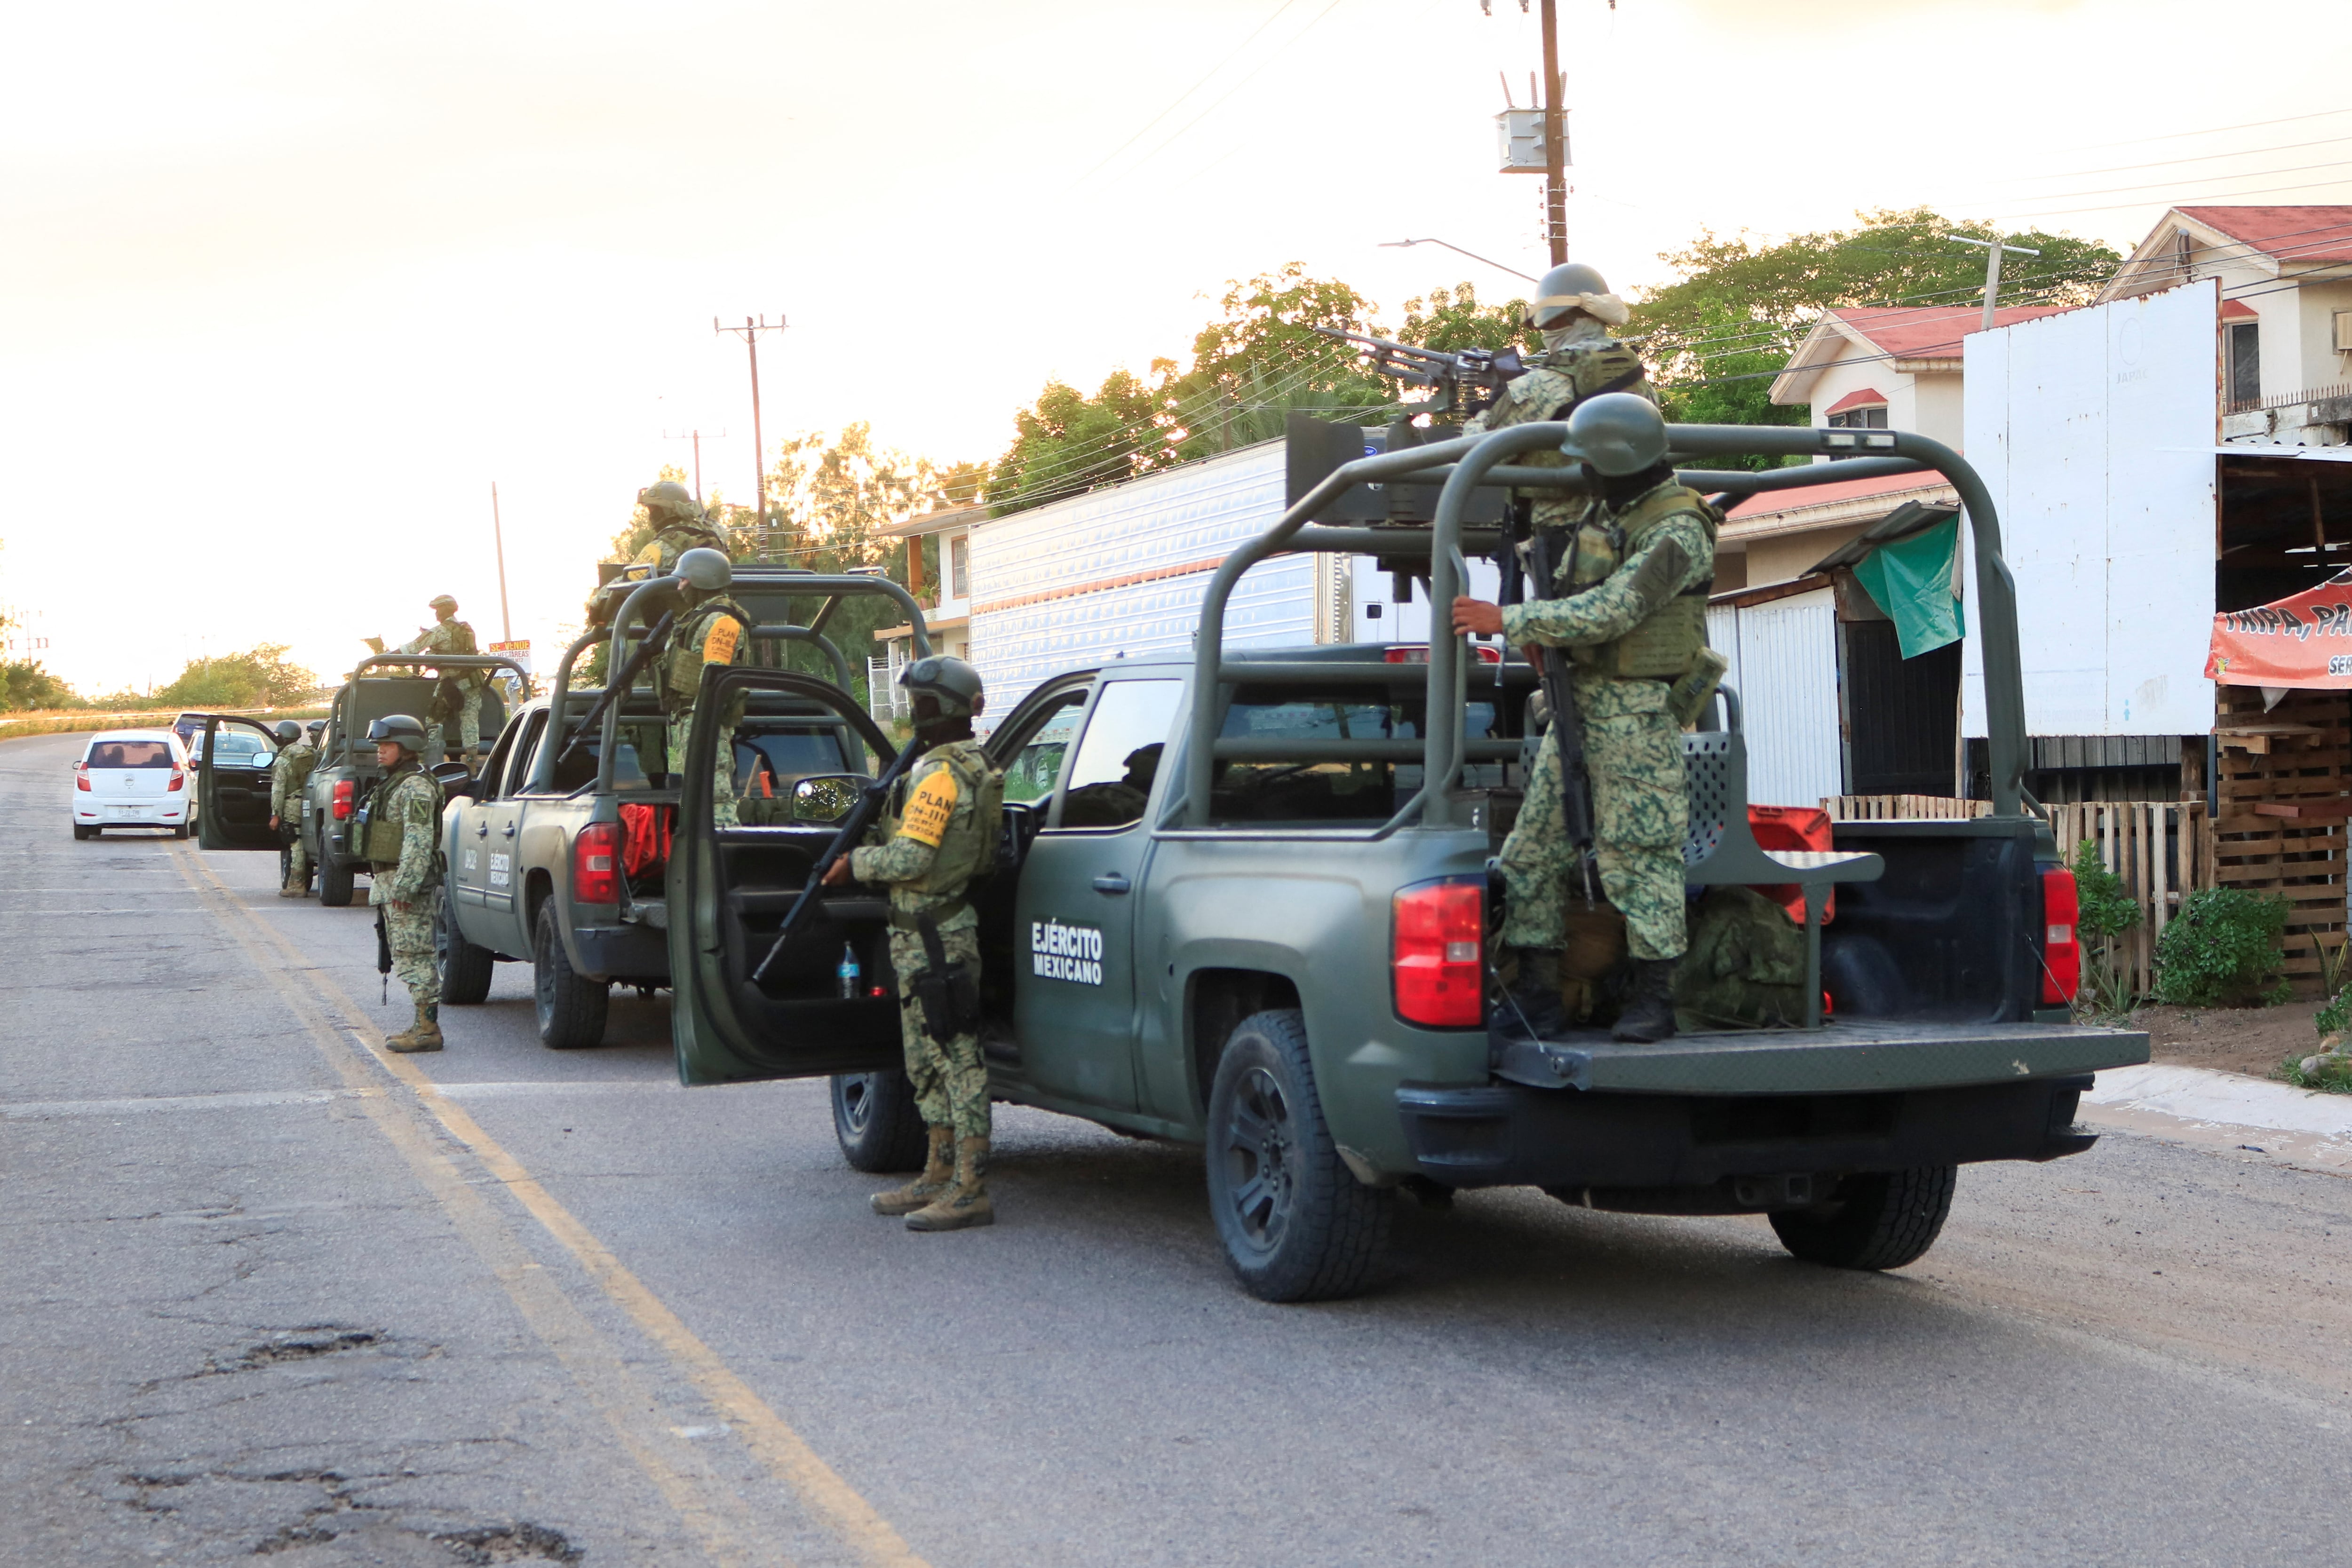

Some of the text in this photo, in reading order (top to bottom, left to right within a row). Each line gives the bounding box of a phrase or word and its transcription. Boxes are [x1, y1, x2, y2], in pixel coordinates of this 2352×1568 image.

[2310, 603, 2352, 636] PA
[491, 641, 529, 652] SE VENDE
[718, 628, 735, 640] PLAN
[920, 792, 952, 812] PLAN
[1032, 917, 1102, 961] EJÉRCITO
[1033, 954, 1102, 985] MEXICANO
